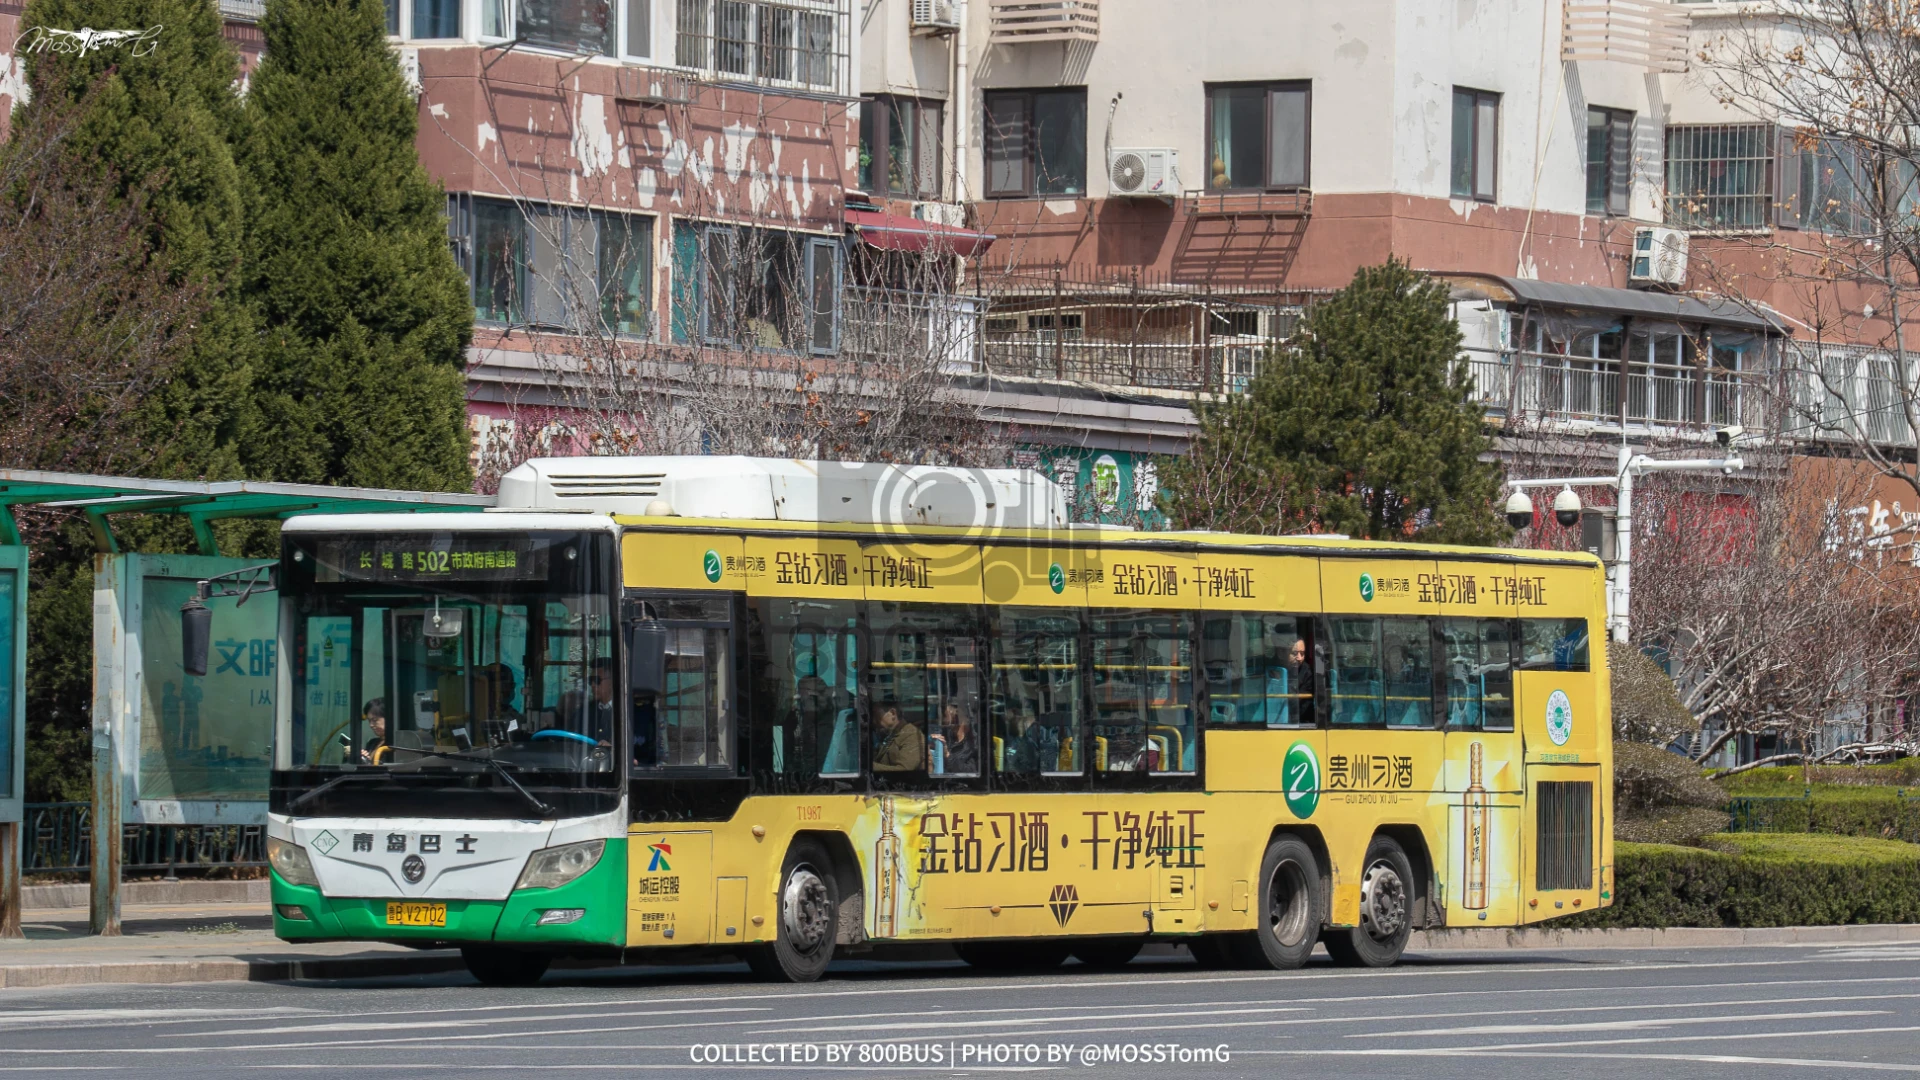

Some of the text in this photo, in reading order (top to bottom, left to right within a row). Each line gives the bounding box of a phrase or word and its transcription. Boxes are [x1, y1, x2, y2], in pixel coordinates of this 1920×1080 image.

[359, 551, 516, 572] 长城路 502 市政府南通路
[726, 556, 766, 572] 贵州习酒
[1069, 569, 1104, 583] 贵州习酒
[1377, 578, 1410, 592] 贵州习酒
[1329, 754, 1413, 788] 贵州习酒
[797, 805, 822, 820] T1987
[316, 837, 335, 848] CNG
[352, 832, 479, 854] 青岛巴士
[639, 876, 680, 895] 城运控股
